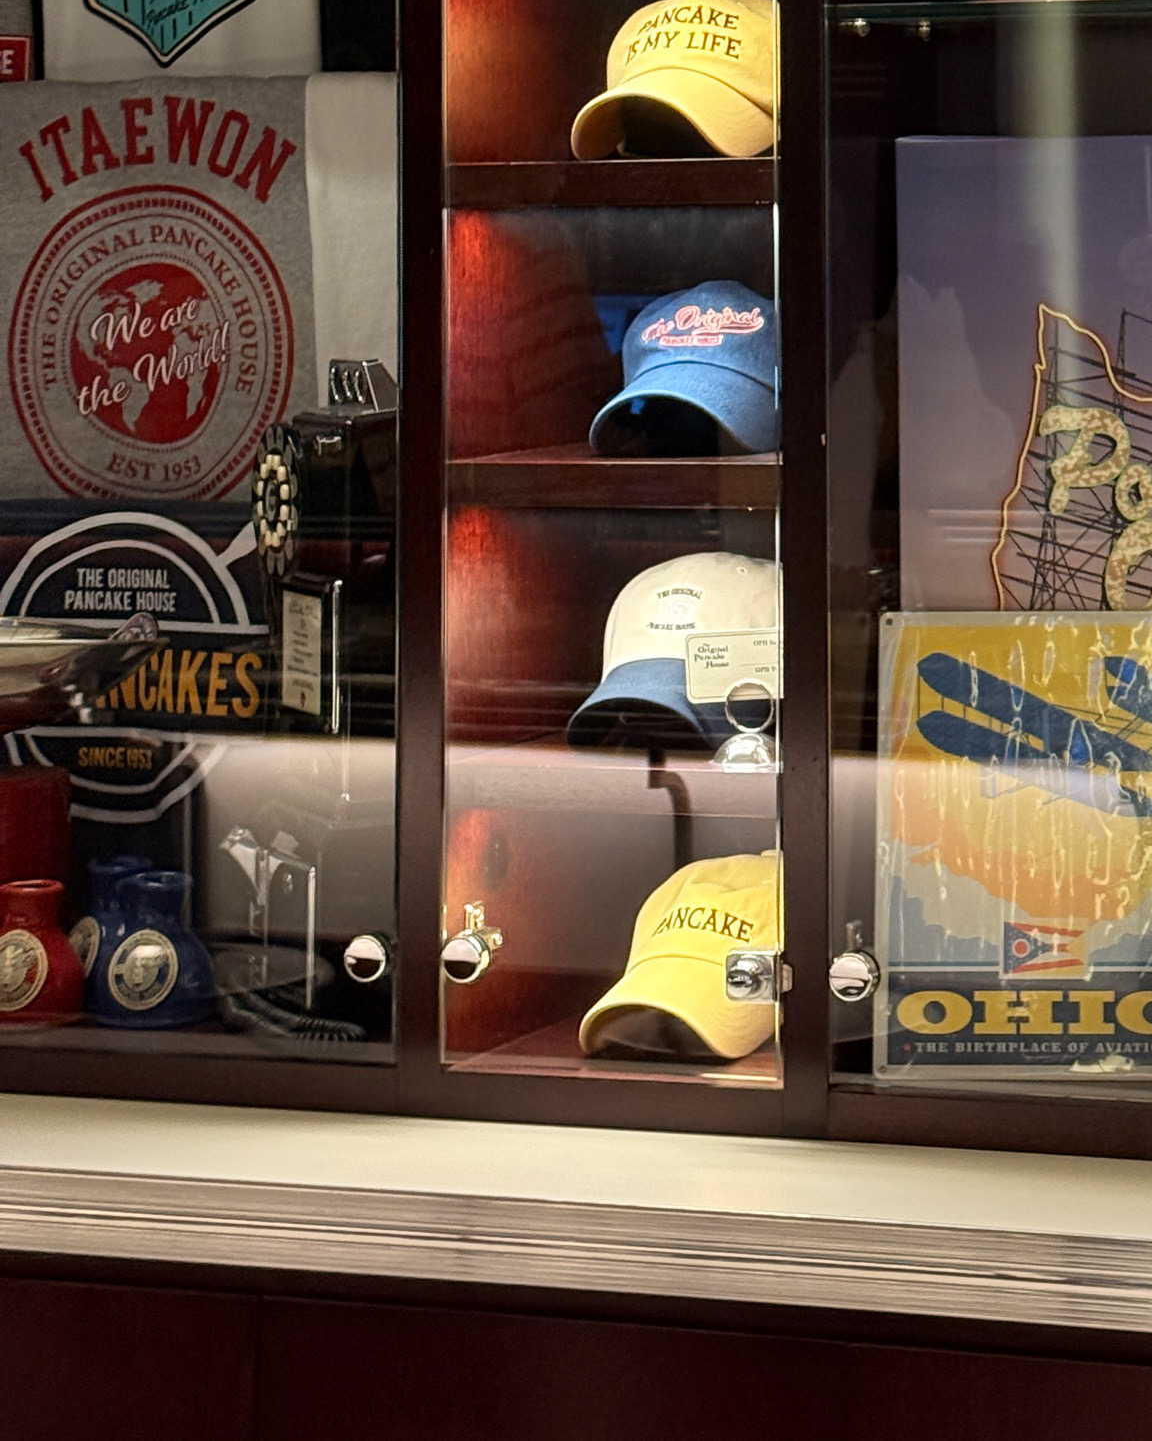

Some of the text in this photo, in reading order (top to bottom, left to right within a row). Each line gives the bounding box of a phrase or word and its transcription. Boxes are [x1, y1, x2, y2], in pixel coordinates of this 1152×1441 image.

[636, 5, 740, 35] PANCAKE
[641, 31, 680, 54] MY
[683, 31, 742, 60] LIFE
[19, 94, 297, 204] ITAEWON
[43, 224, 259, 396] THE ORIGINAL PANCAKE HOUSE
[91, 292, 198, 351] We are
[675, 305, 765, 335] Original
[77, 320, 230, 417] the World!
[106, 452, 202, 483] EST 1953
[76, 567, 170, 590] THE ORIGINAL
[64, 589, 177, 613] PANCAKE HOUSE
[95, 649, 262, 718] NCAKES
[78, 747, 124, 768] SINCE
[650, 906, 754, 944] PANCAKE
[915, 1042, 949, 1054] THE
[954, 1042, 1063, 1054] BIRTHPLACE
[1067, 1042, 1090, 1054] OF
